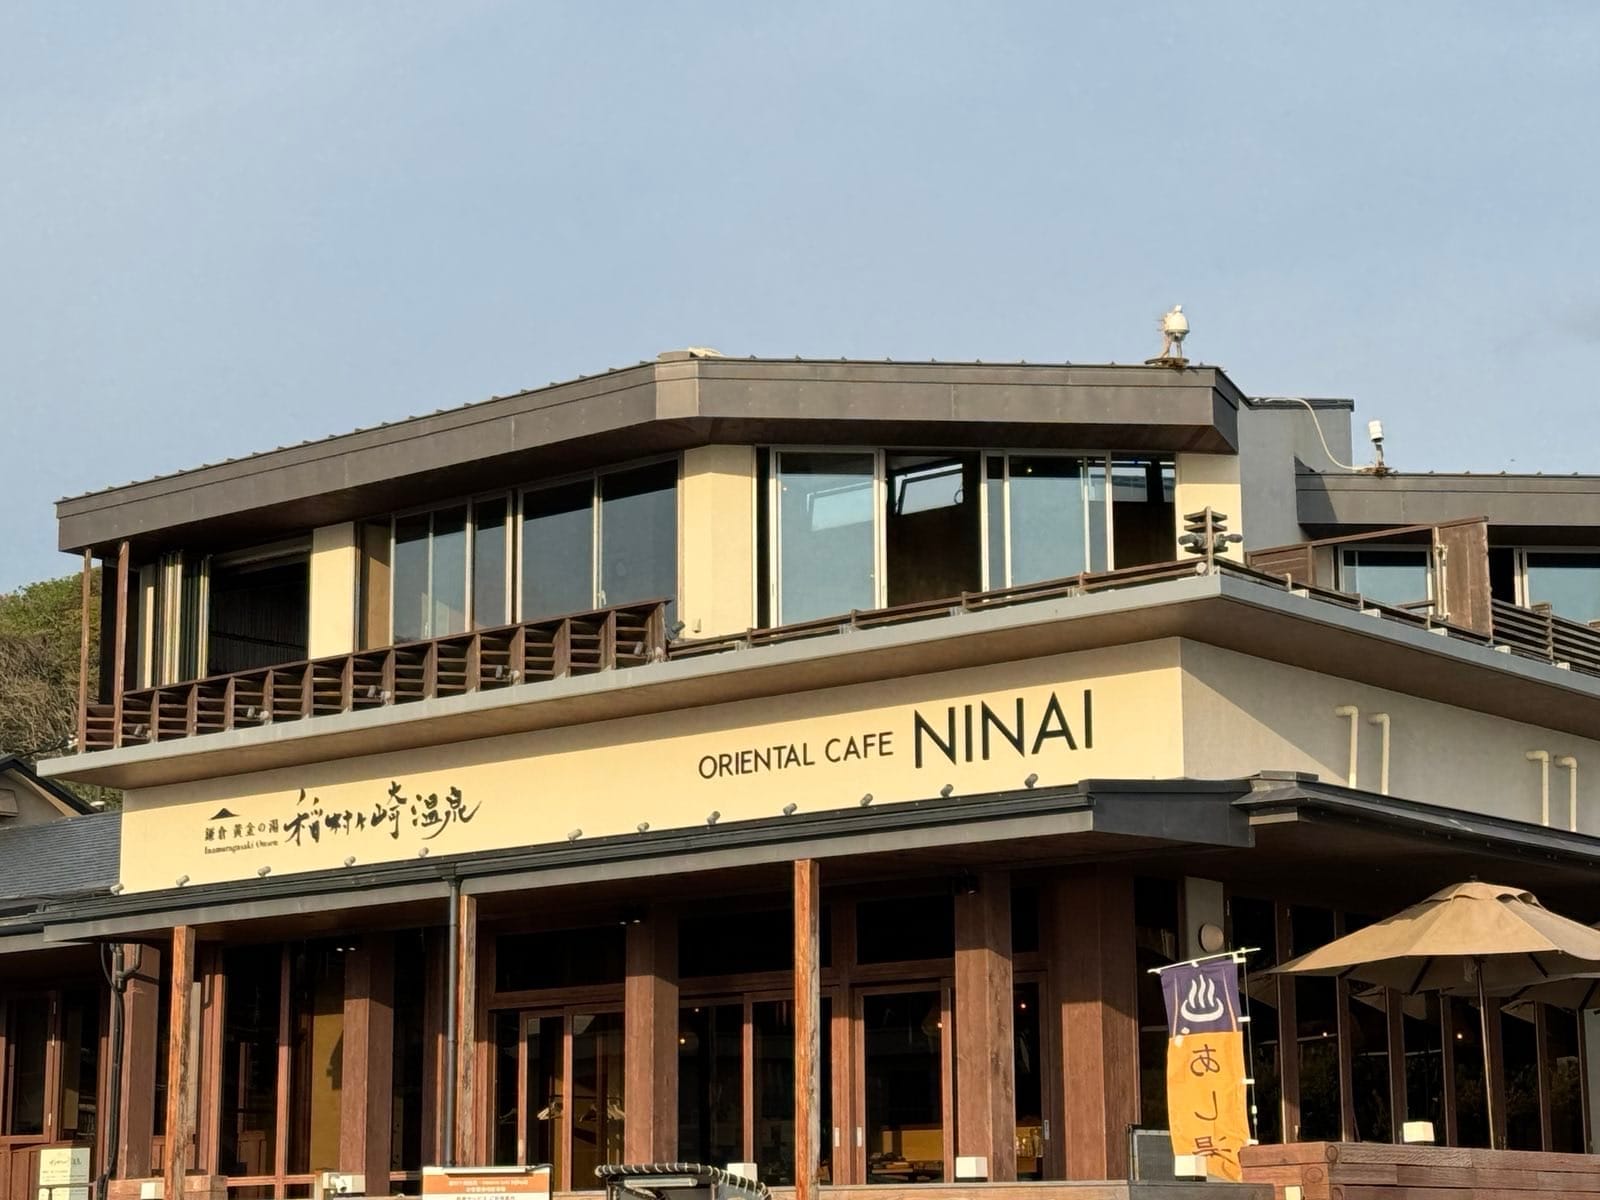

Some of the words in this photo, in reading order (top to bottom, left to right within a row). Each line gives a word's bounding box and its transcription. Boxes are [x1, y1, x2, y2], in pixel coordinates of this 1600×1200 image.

[698, 743, 815, 779] ORIENTAL
[825, 731, 894, 763] CAFE
[914, 688, 1093, 769] NINAI
